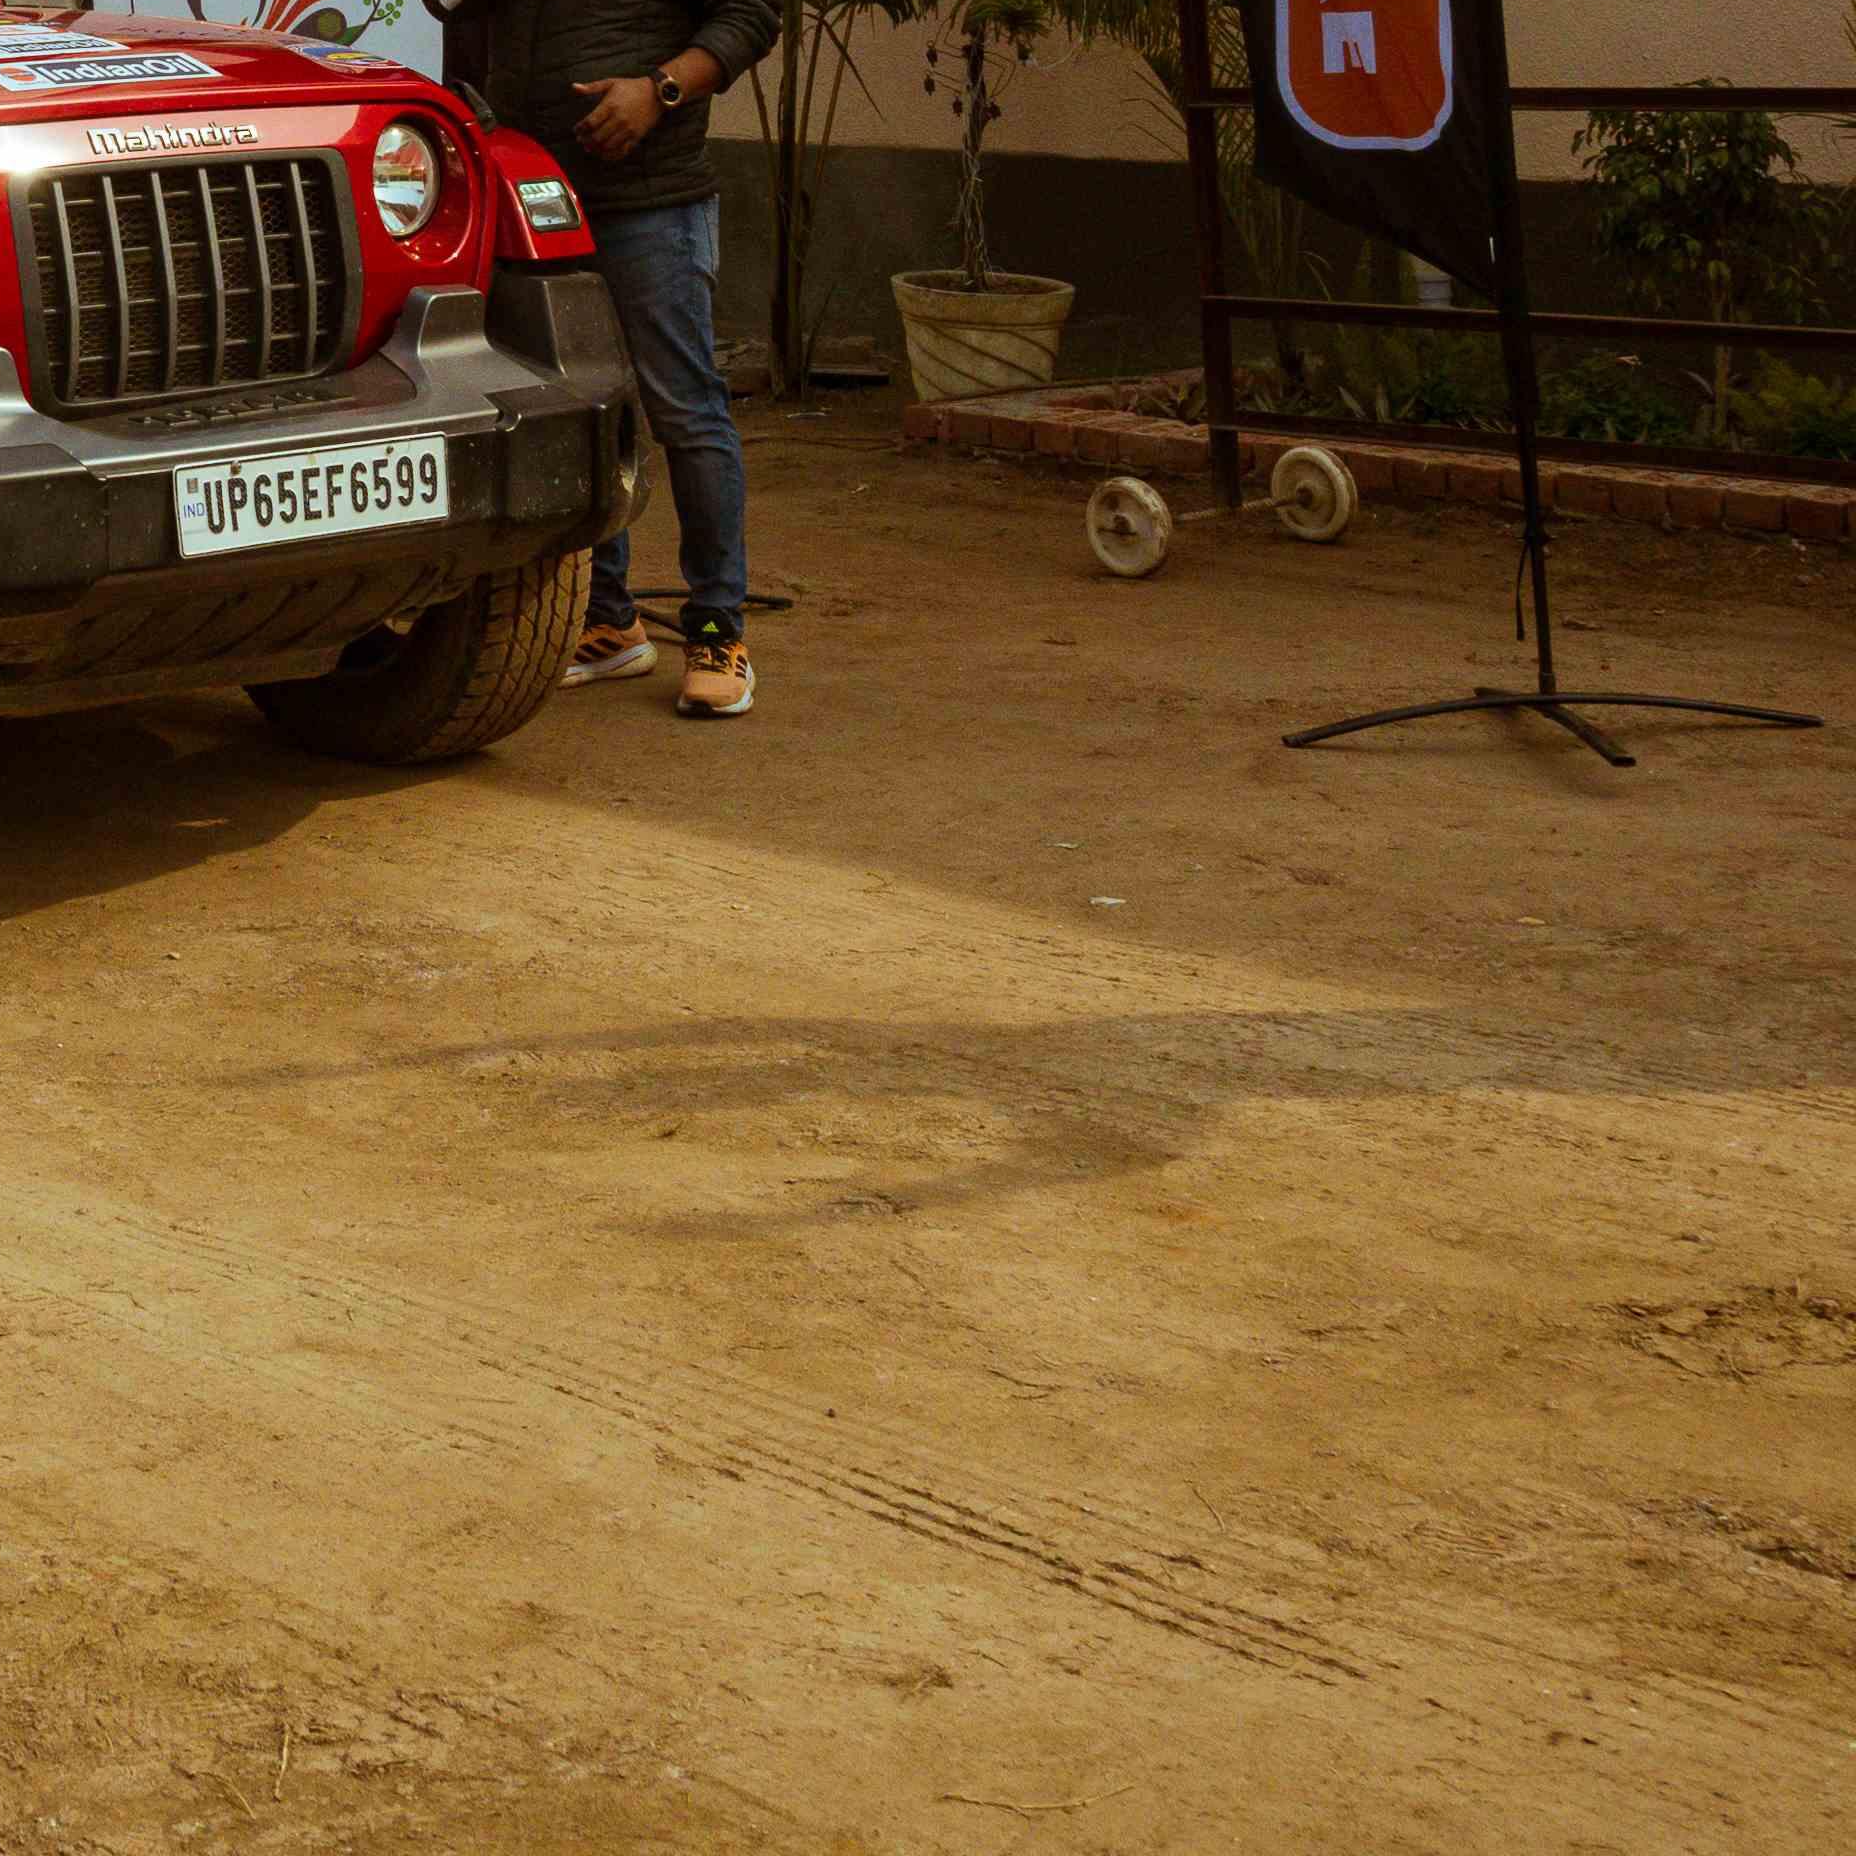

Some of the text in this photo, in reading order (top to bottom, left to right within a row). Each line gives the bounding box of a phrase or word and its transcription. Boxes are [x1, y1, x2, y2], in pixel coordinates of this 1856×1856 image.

[35, 53, 202, 82] IndianOil
[204, 452, 438, 534] UP65EF6599
[183, 501, 205, 519] IND
